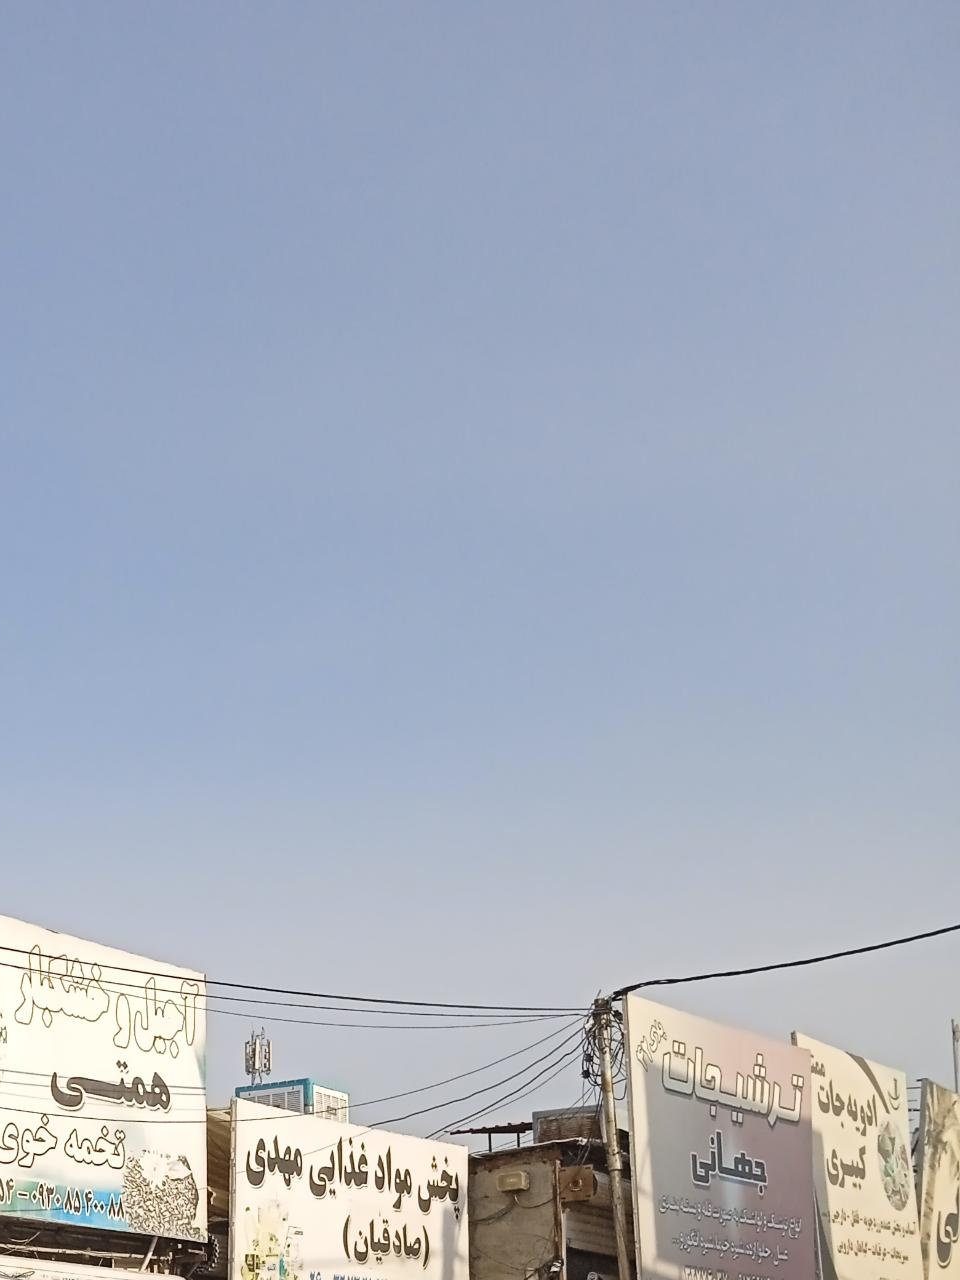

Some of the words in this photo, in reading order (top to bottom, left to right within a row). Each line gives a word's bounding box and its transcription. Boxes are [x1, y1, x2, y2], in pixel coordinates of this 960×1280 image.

[14, 944, 111, 1028] خشکبار
[133, 977, 199, 1059] آجیل
[113, 993, 131, 1049] و
[50, 1060, 172, 1112] همتی
[661, 1040, 805, 1128] ترشیجات
[846, 1094, 878, 1136] ادویه
[64, 1125, 126, 1169] تخمه
[245, 1135, 304, 1188] مهدی
[309, 1136, 369, 1200] غذایی
[374, 1145, 412, 1210] مواد
[691, 1129, 768, 1195] جهانی
[826, 1145, 866, 1190] کبیری
[418, 1154, 460, 1220] پخش
